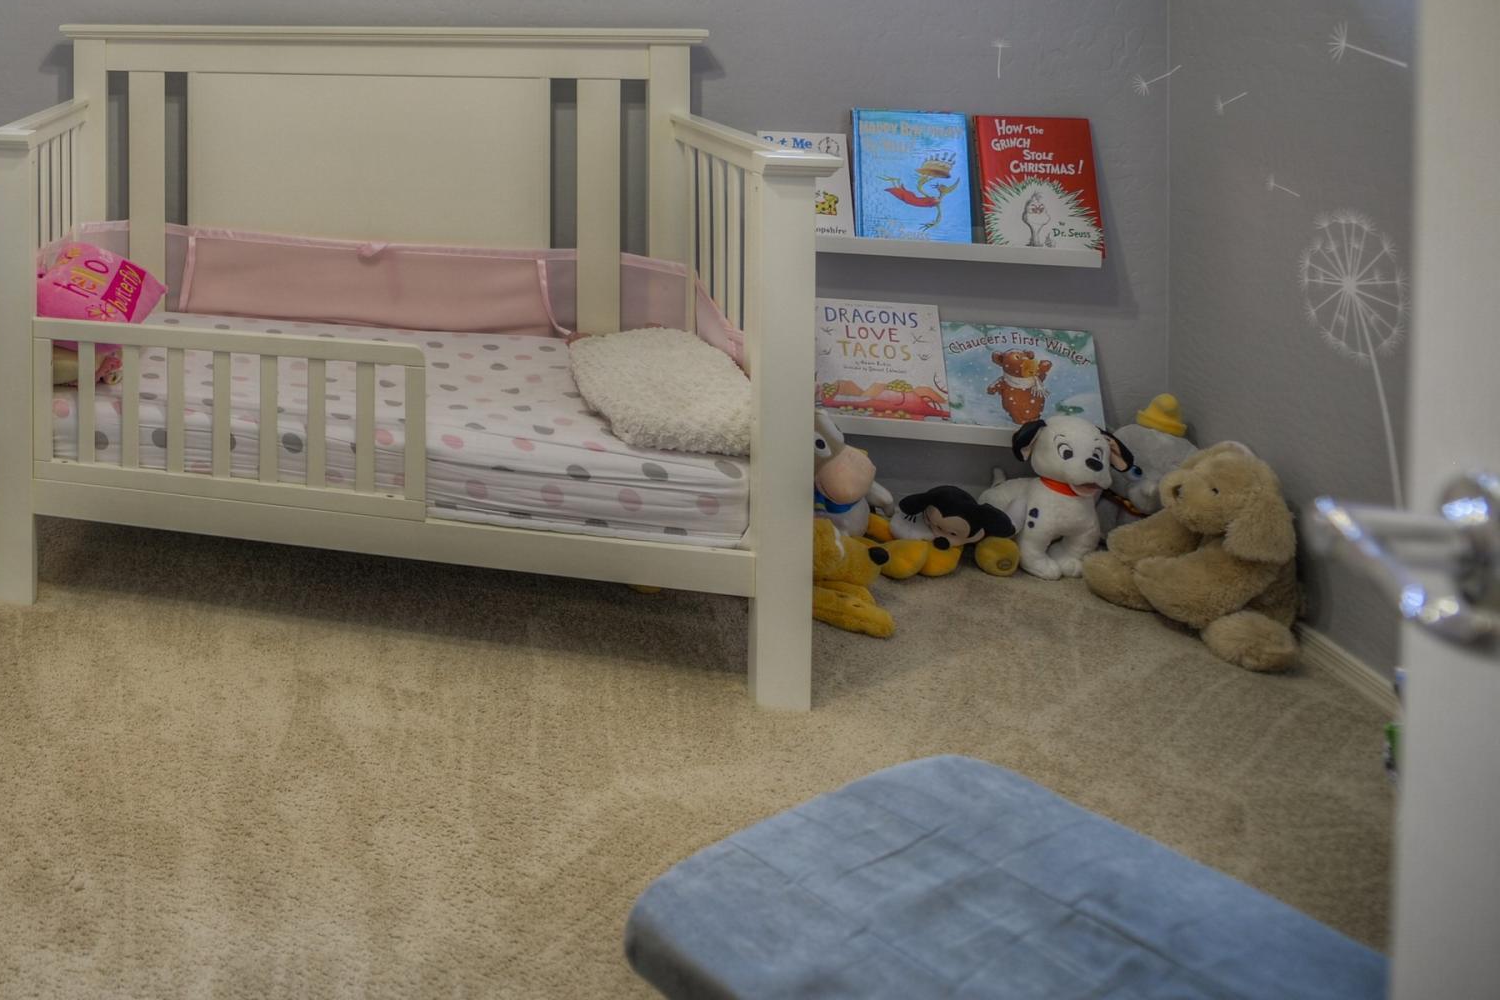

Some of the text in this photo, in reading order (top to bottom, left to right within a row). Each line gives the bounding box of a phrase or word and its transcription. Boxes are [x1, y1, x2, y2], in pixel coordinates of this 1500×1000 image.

[791, 137, 813, 149] Me
[991, 137, 1031, 152] GRINCH
[1022, 149, 1054, 161] STOLE
[108, 265, 141, 313] butterfly
[824, 306, 918, 328] DRAGONS
[845, 325, 900, 342] LOVE
[836, 340, 911, 361] TACOS
[948, 332, 1092, 366] Chaucer's First Winter
